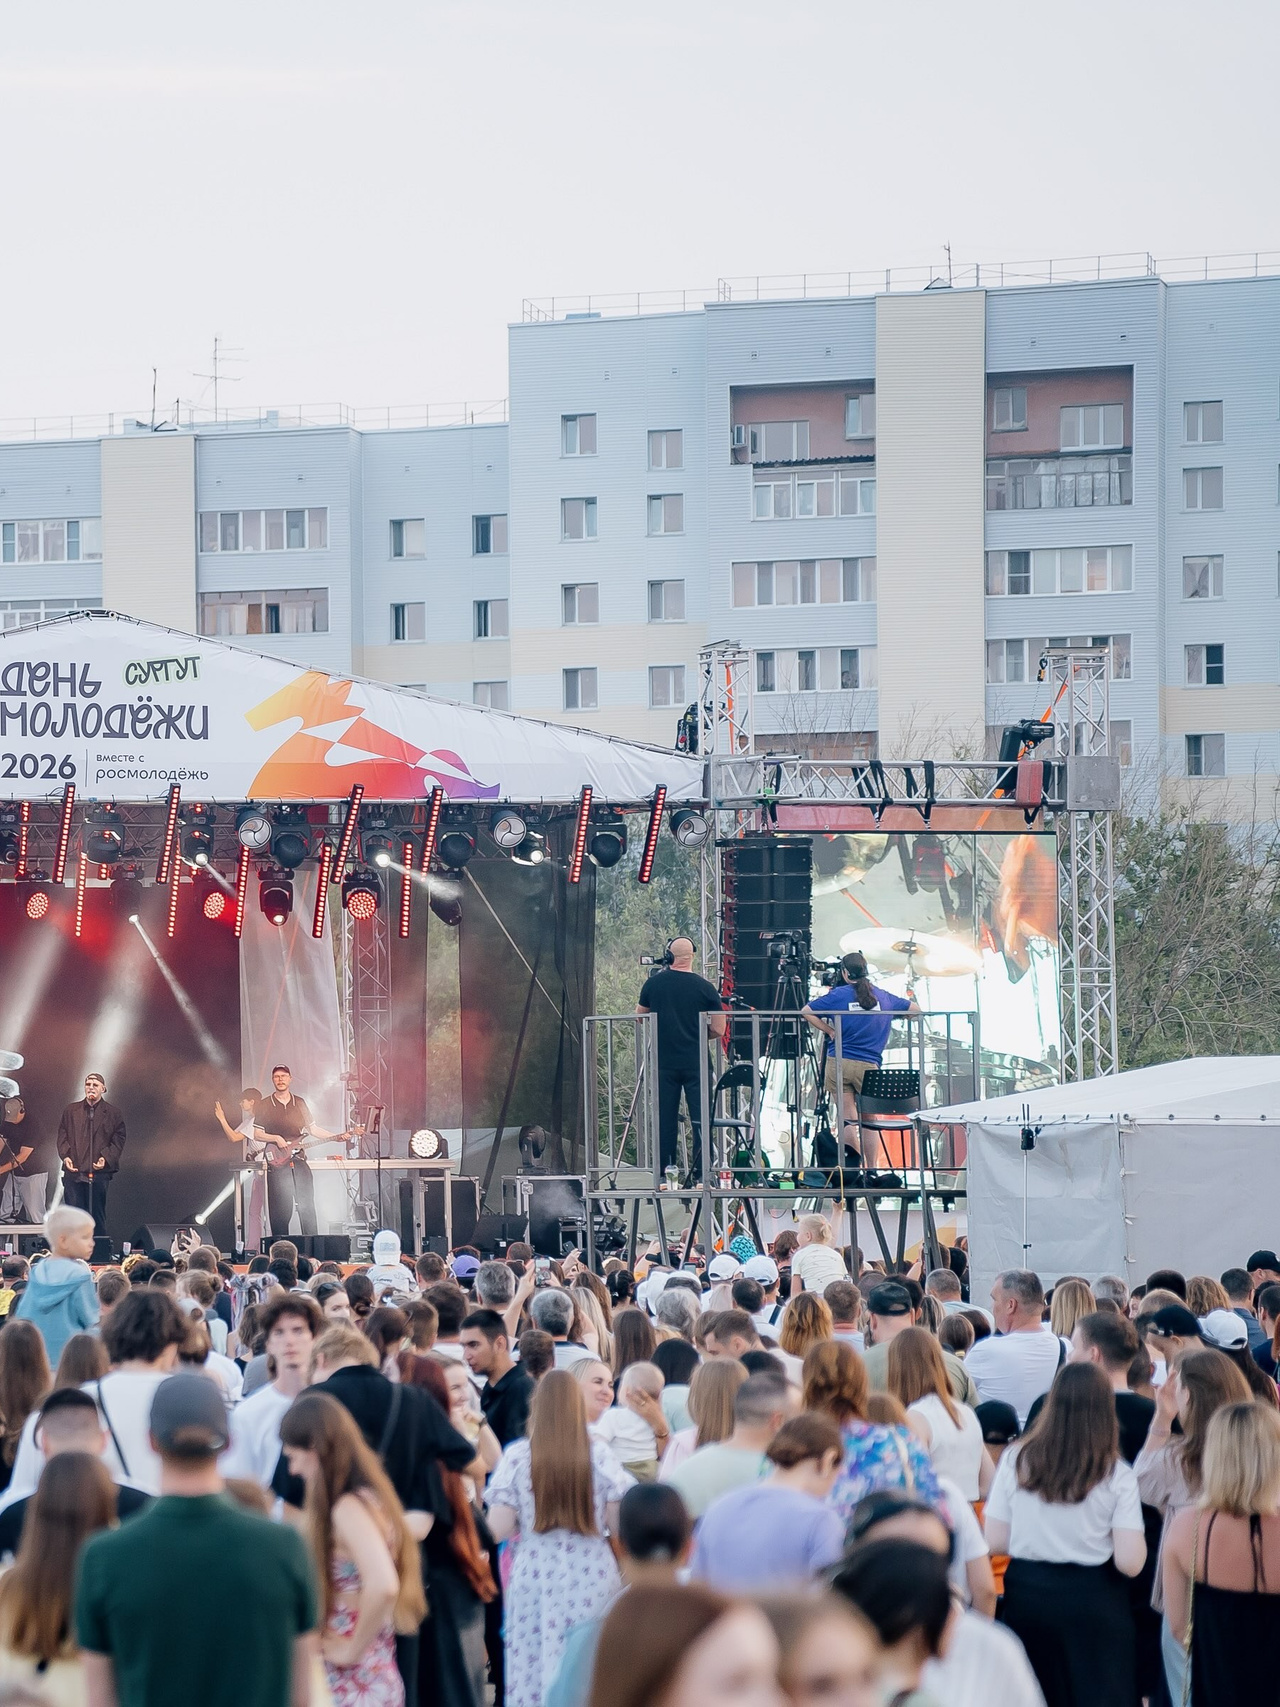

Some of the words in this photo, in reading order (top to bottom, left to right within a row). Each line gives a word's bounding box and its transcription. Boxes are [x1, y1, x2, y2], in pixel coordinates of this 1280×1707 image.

[125, 656, 200, 685] СУРГУТ
[1, 753, 76, 779] 2026
[96, 754, 135, 763] вместе
[138, 755, 145, 763] с
[96, 767, 209, 783] росмолодёжь
